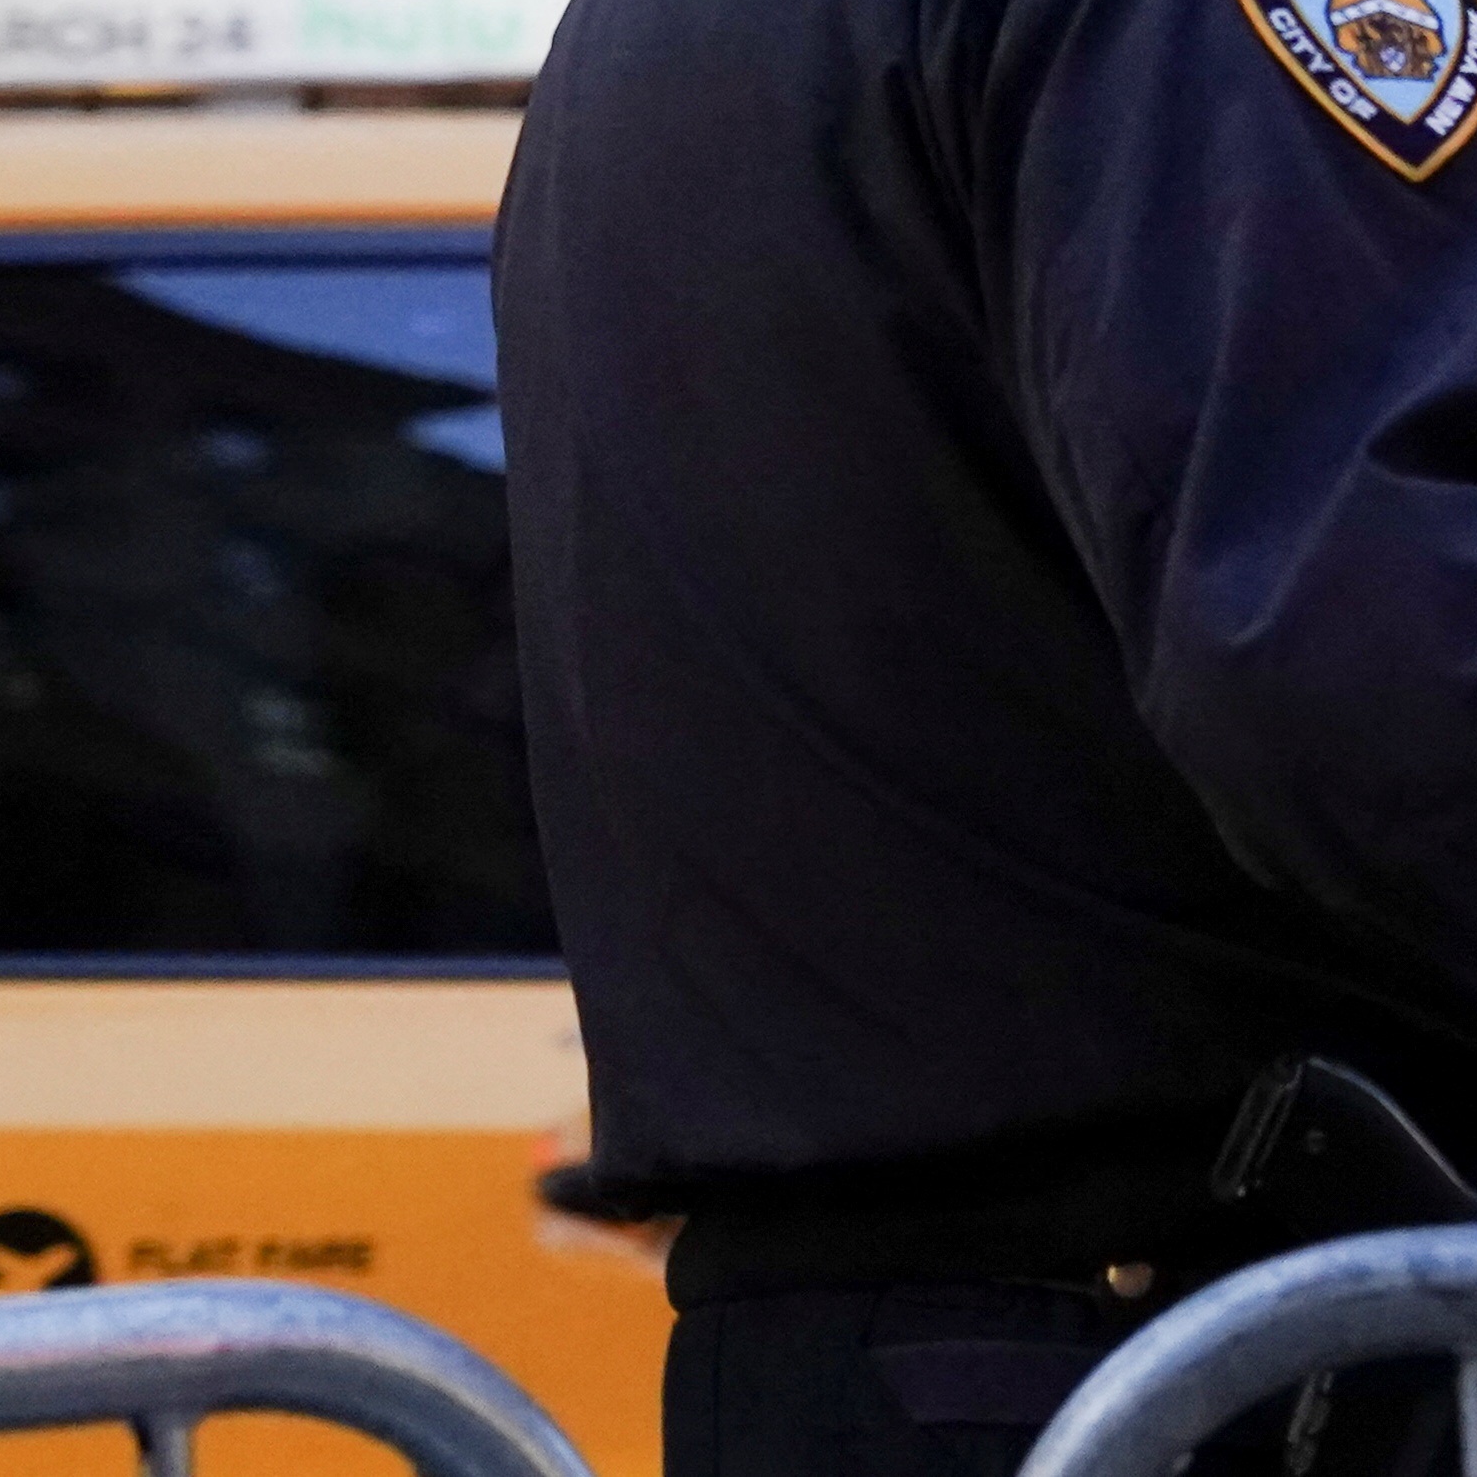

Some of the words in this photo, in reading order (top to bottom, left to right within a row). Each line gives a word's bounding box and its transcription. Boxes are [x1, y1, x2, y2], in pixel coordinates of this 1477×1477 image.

[175, 7, 257, 56] 24
[1269, 7, 1335, 74] CITY
[1328, 78, 1379, 120] OF
[1425, 76, 1476, 136] NEW
